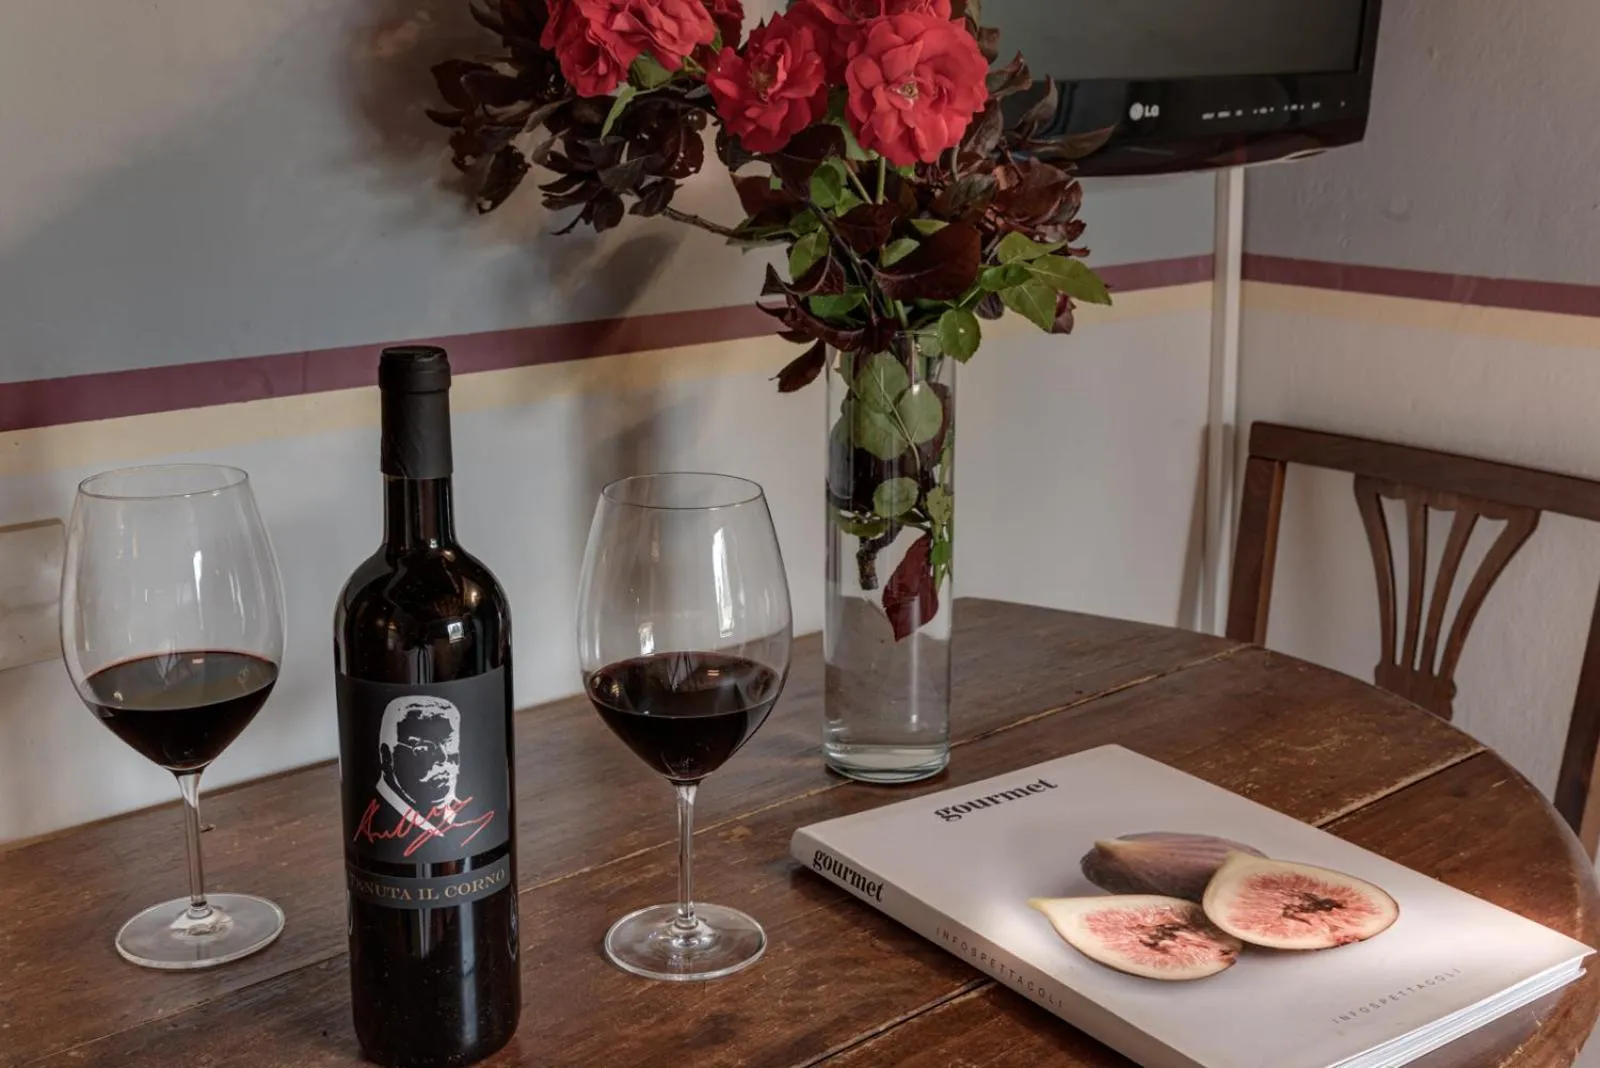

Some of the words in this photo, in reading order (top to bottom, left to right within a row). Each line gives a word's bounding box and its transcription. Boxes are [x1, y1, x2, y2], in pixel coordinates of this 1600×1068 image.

[934, 777, 1058, 822] gourmet
[418, 887, 440, 900] IL
[444, 868, 505, 898] CORNO
[812, 849, 884, 902] gourmet
[935, 926, 1063, 1009] INFOSPETTACOLI
[1332, 968, 1462, 1025] INFOSPETTACOLI
